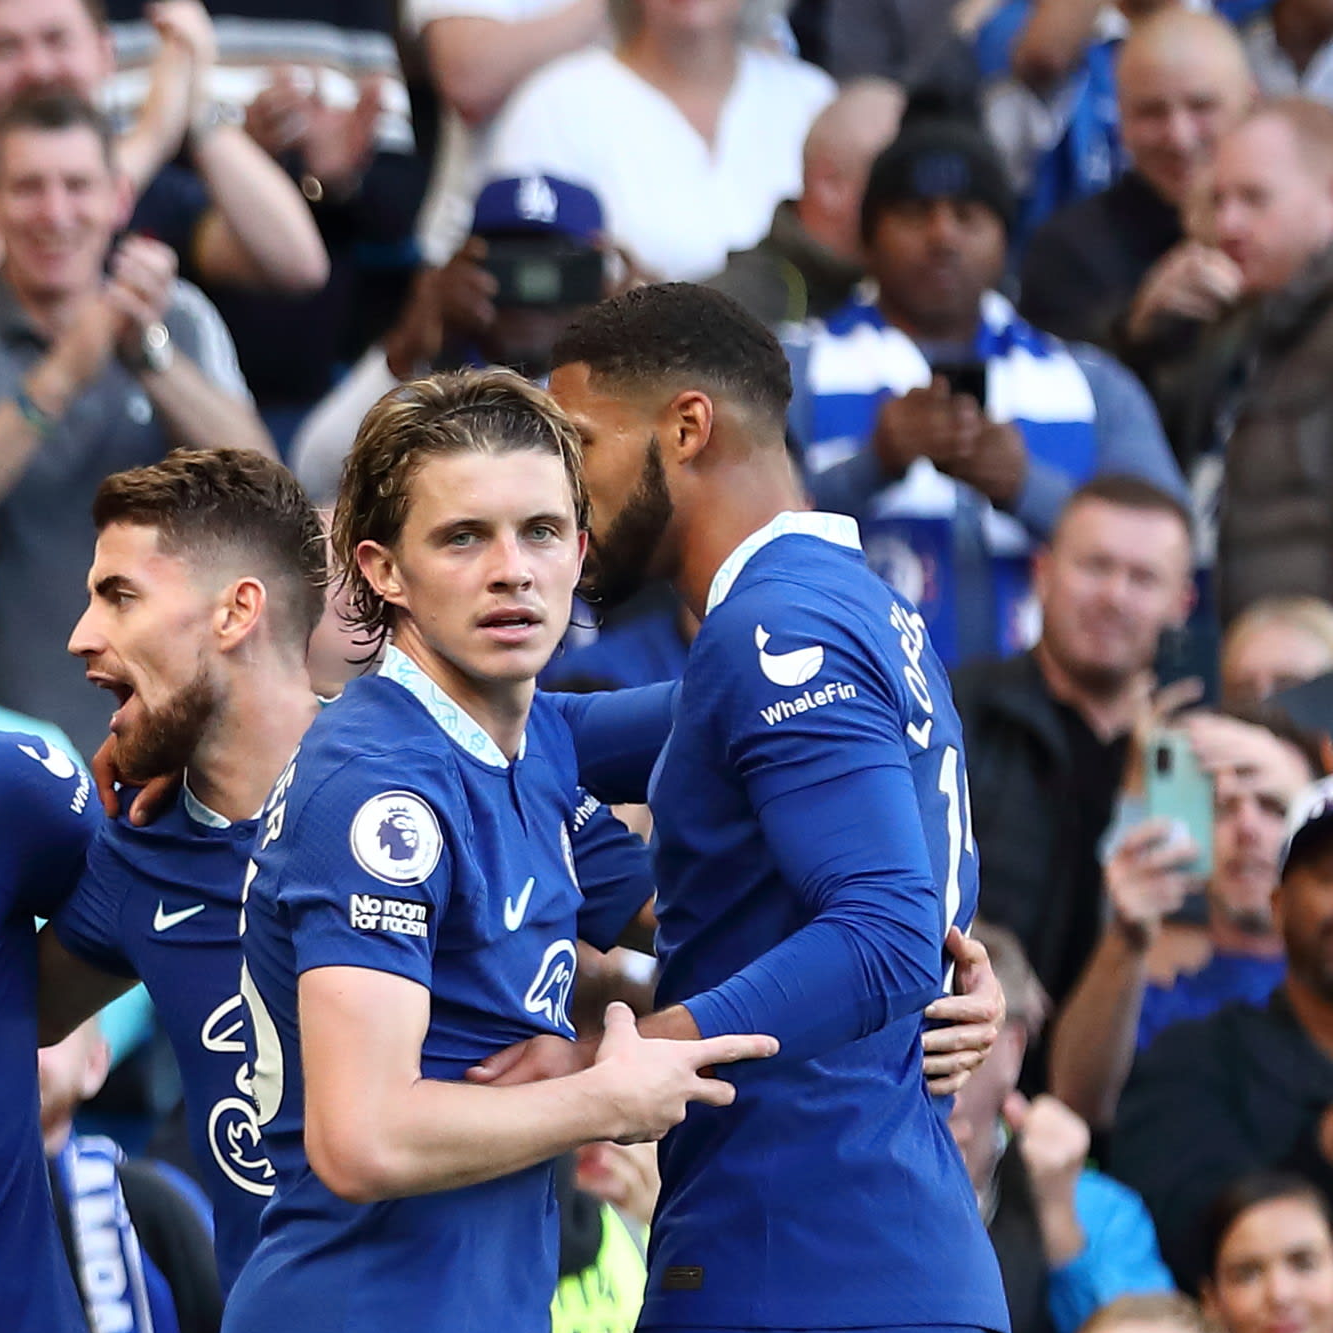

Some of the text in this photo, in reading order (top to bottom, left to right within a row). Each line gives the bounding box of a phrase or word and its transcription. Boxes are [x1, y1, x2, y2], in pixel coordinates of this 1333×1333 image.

[759, 681, 858, 727] WhaleFin
[350, 894, 426, 921] No room
[382, 917, 428, 938] racism
